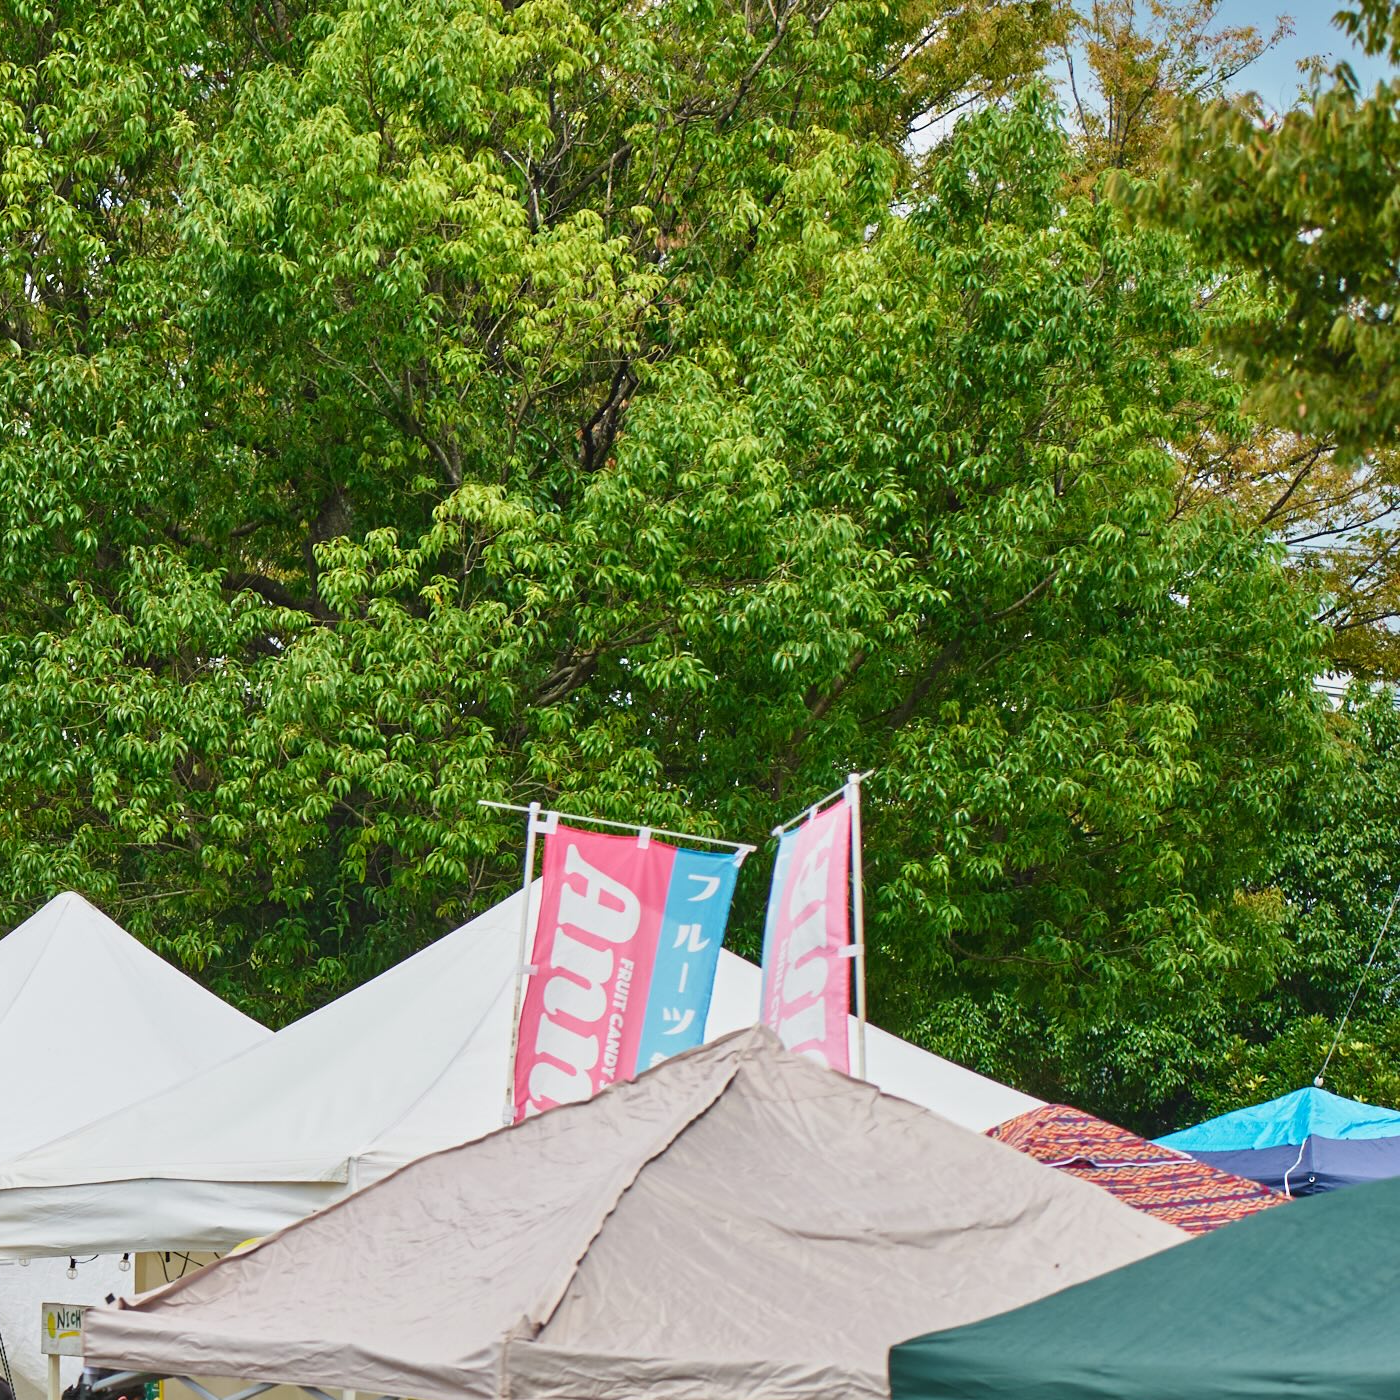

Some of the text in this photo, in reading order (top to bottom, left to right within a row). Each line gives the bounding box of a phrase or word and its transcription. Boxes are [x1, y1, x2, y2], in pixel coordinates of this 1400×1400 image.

[600, 958, 635, 1080] FRUIT CANDY
[57, 1308, 83, 1330] NICH
